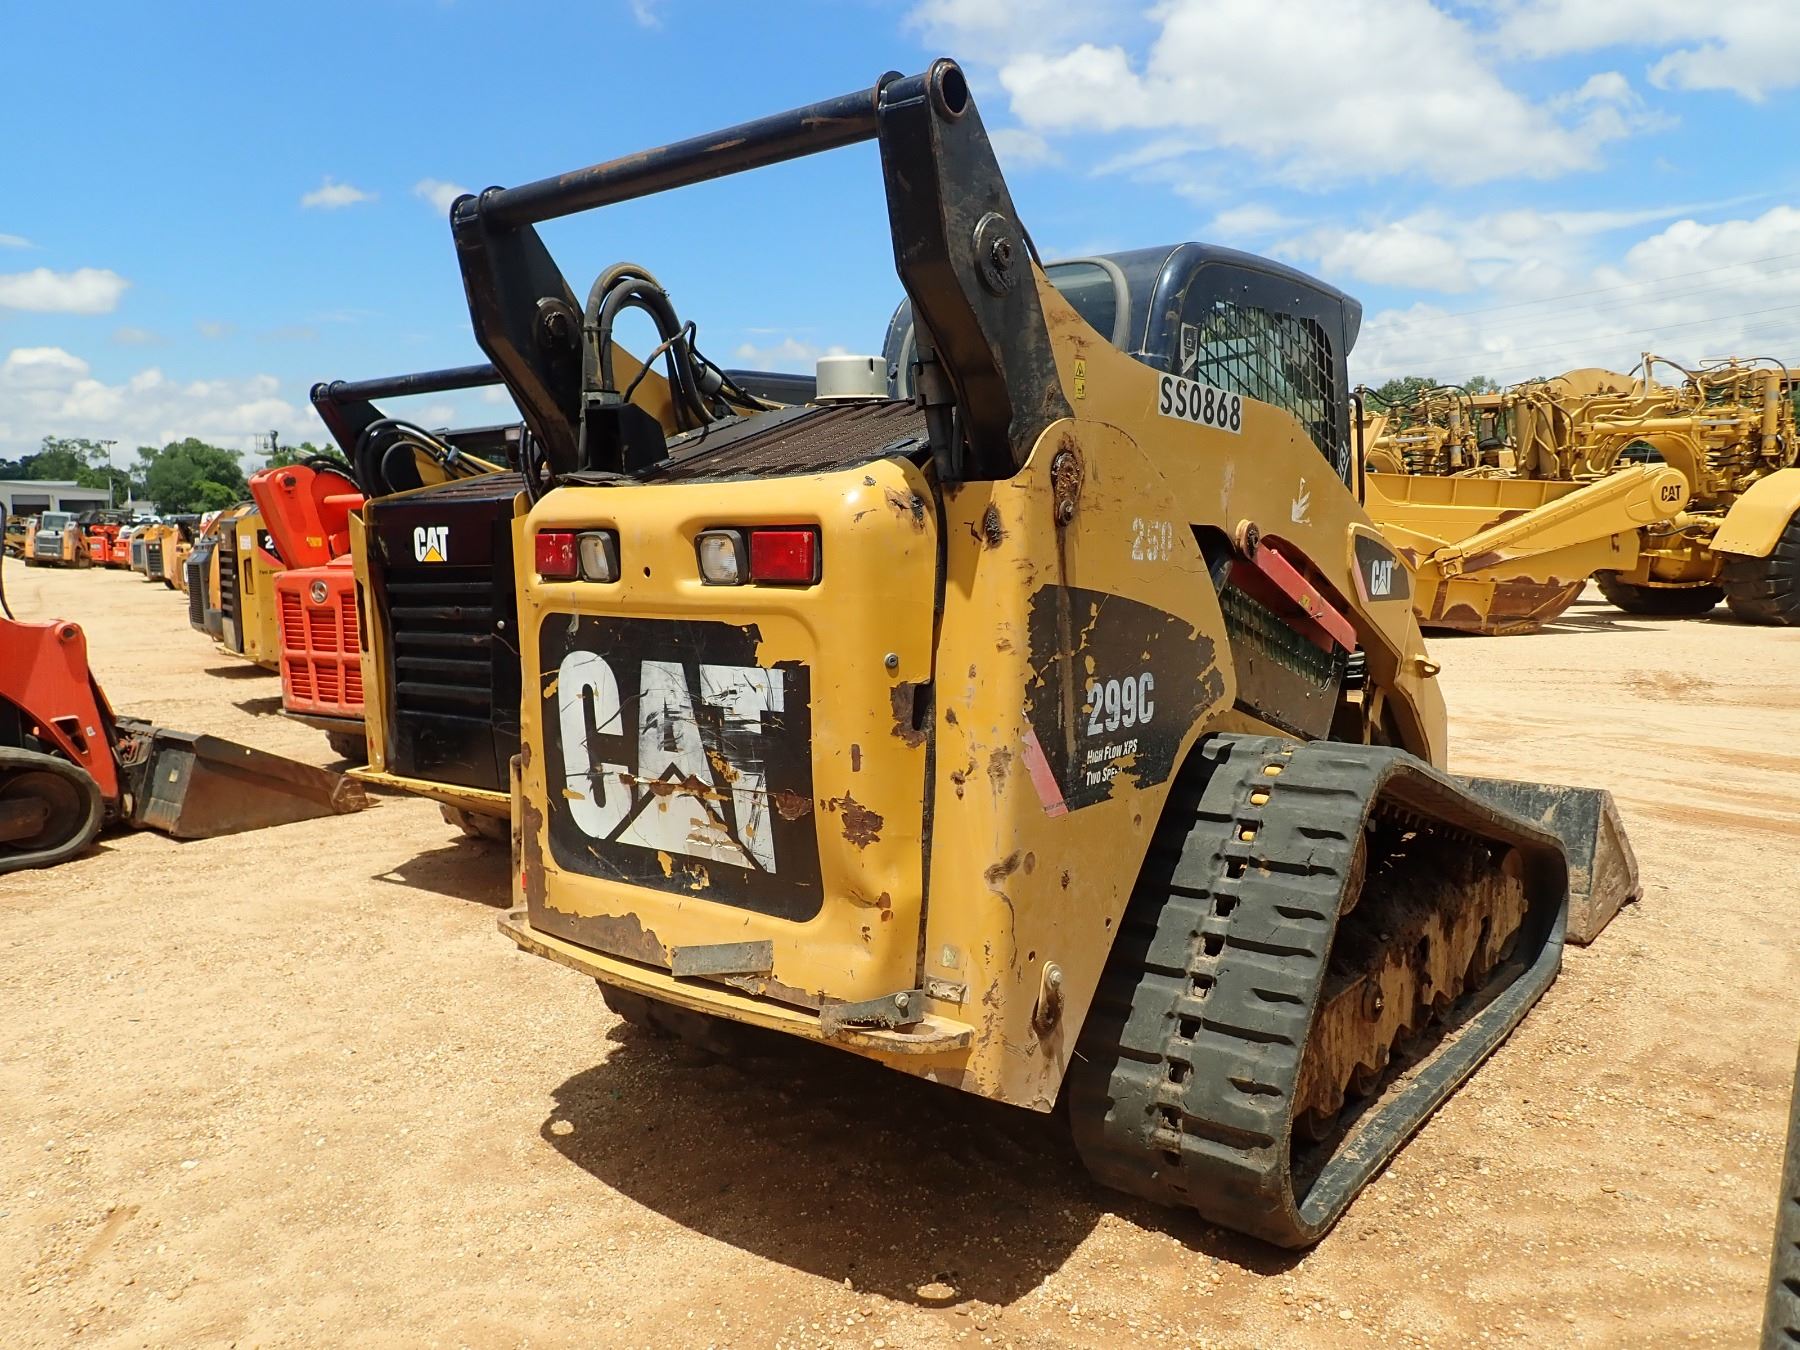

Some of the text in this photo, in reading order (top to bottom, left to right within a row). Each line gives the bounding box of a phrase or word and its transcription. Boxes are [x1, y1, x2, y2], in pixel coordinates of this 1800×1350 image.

[1160, 376, 1241, 432] SS0868
[1661, 484, 1681, 502] CAT
[413, 526, 449, 562] CAT
[1371, 559, 1393, 596] CAT
[1087, 672, 1155, 736] 299C
[558, 650, 785, 875] CAT
[1122, 738, 1138, 756] XPS
